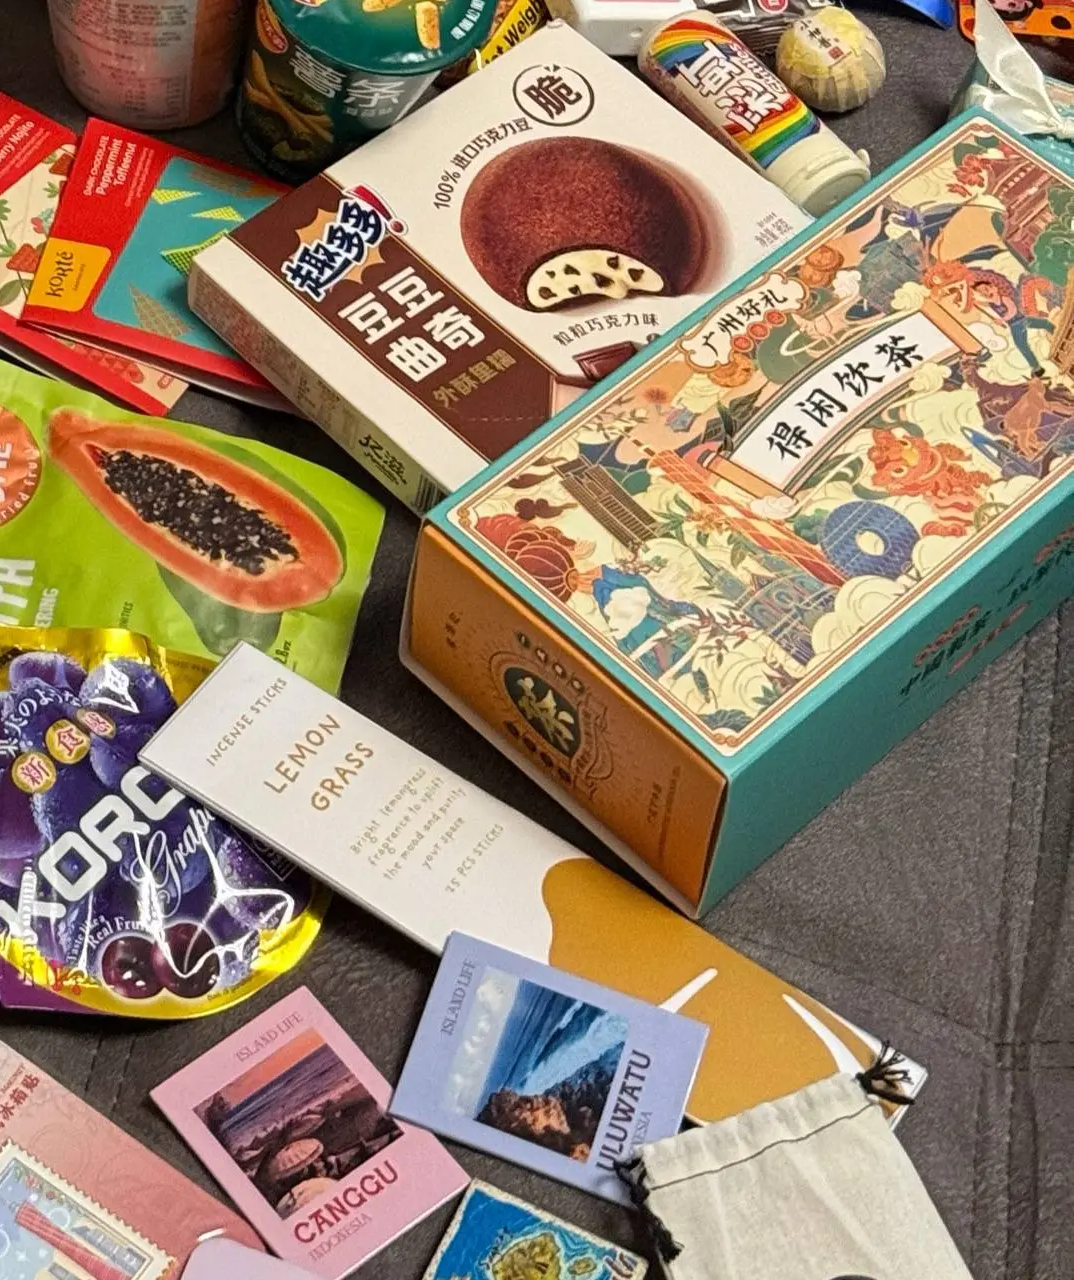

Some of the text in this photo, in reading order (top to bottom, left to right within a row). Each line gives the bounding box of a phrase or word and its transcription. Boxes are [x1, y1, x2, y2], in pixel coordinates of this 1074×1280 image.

[523, 77, 583, 120] 脆
[95, 138, 123, 196] Peppermint
[113, 142, 137, 186] Toffeenut
[434, 117, 533, 210] 100% 进口巧克力豆
[283, 200, 387, 303] 趣多多
[338, 267, 444, 346] 豆豆
[554, 312, 661, 347] 粒粒巧克力味
[701, 289, 790, 359] 广州好礼
[386, 305, 486, 384] 曲奇
[766, 335, 925, 460] 得闲饮茶
[206, 677, 288, 768] INCENSE STICKS
[263, 714, 341, 794] LEMON
[310, 741, 375, 813] GRASS
[401, 831, 426, 860] mood
[424, 813, 441, 833] and
[456, 854, 476, 877] PCS
[475, 823, 505, 856] STICKS
[441, 959, 477, 1037] ISLAND LIFE
[233, 1011, 305, 1063] ISLAND LIFE
[596, 1050, 651, 1172] ULUWATU
[292, 1163, 401, 1245] CANGGU
[308, 1211, 374, 1265] INDONESIA
